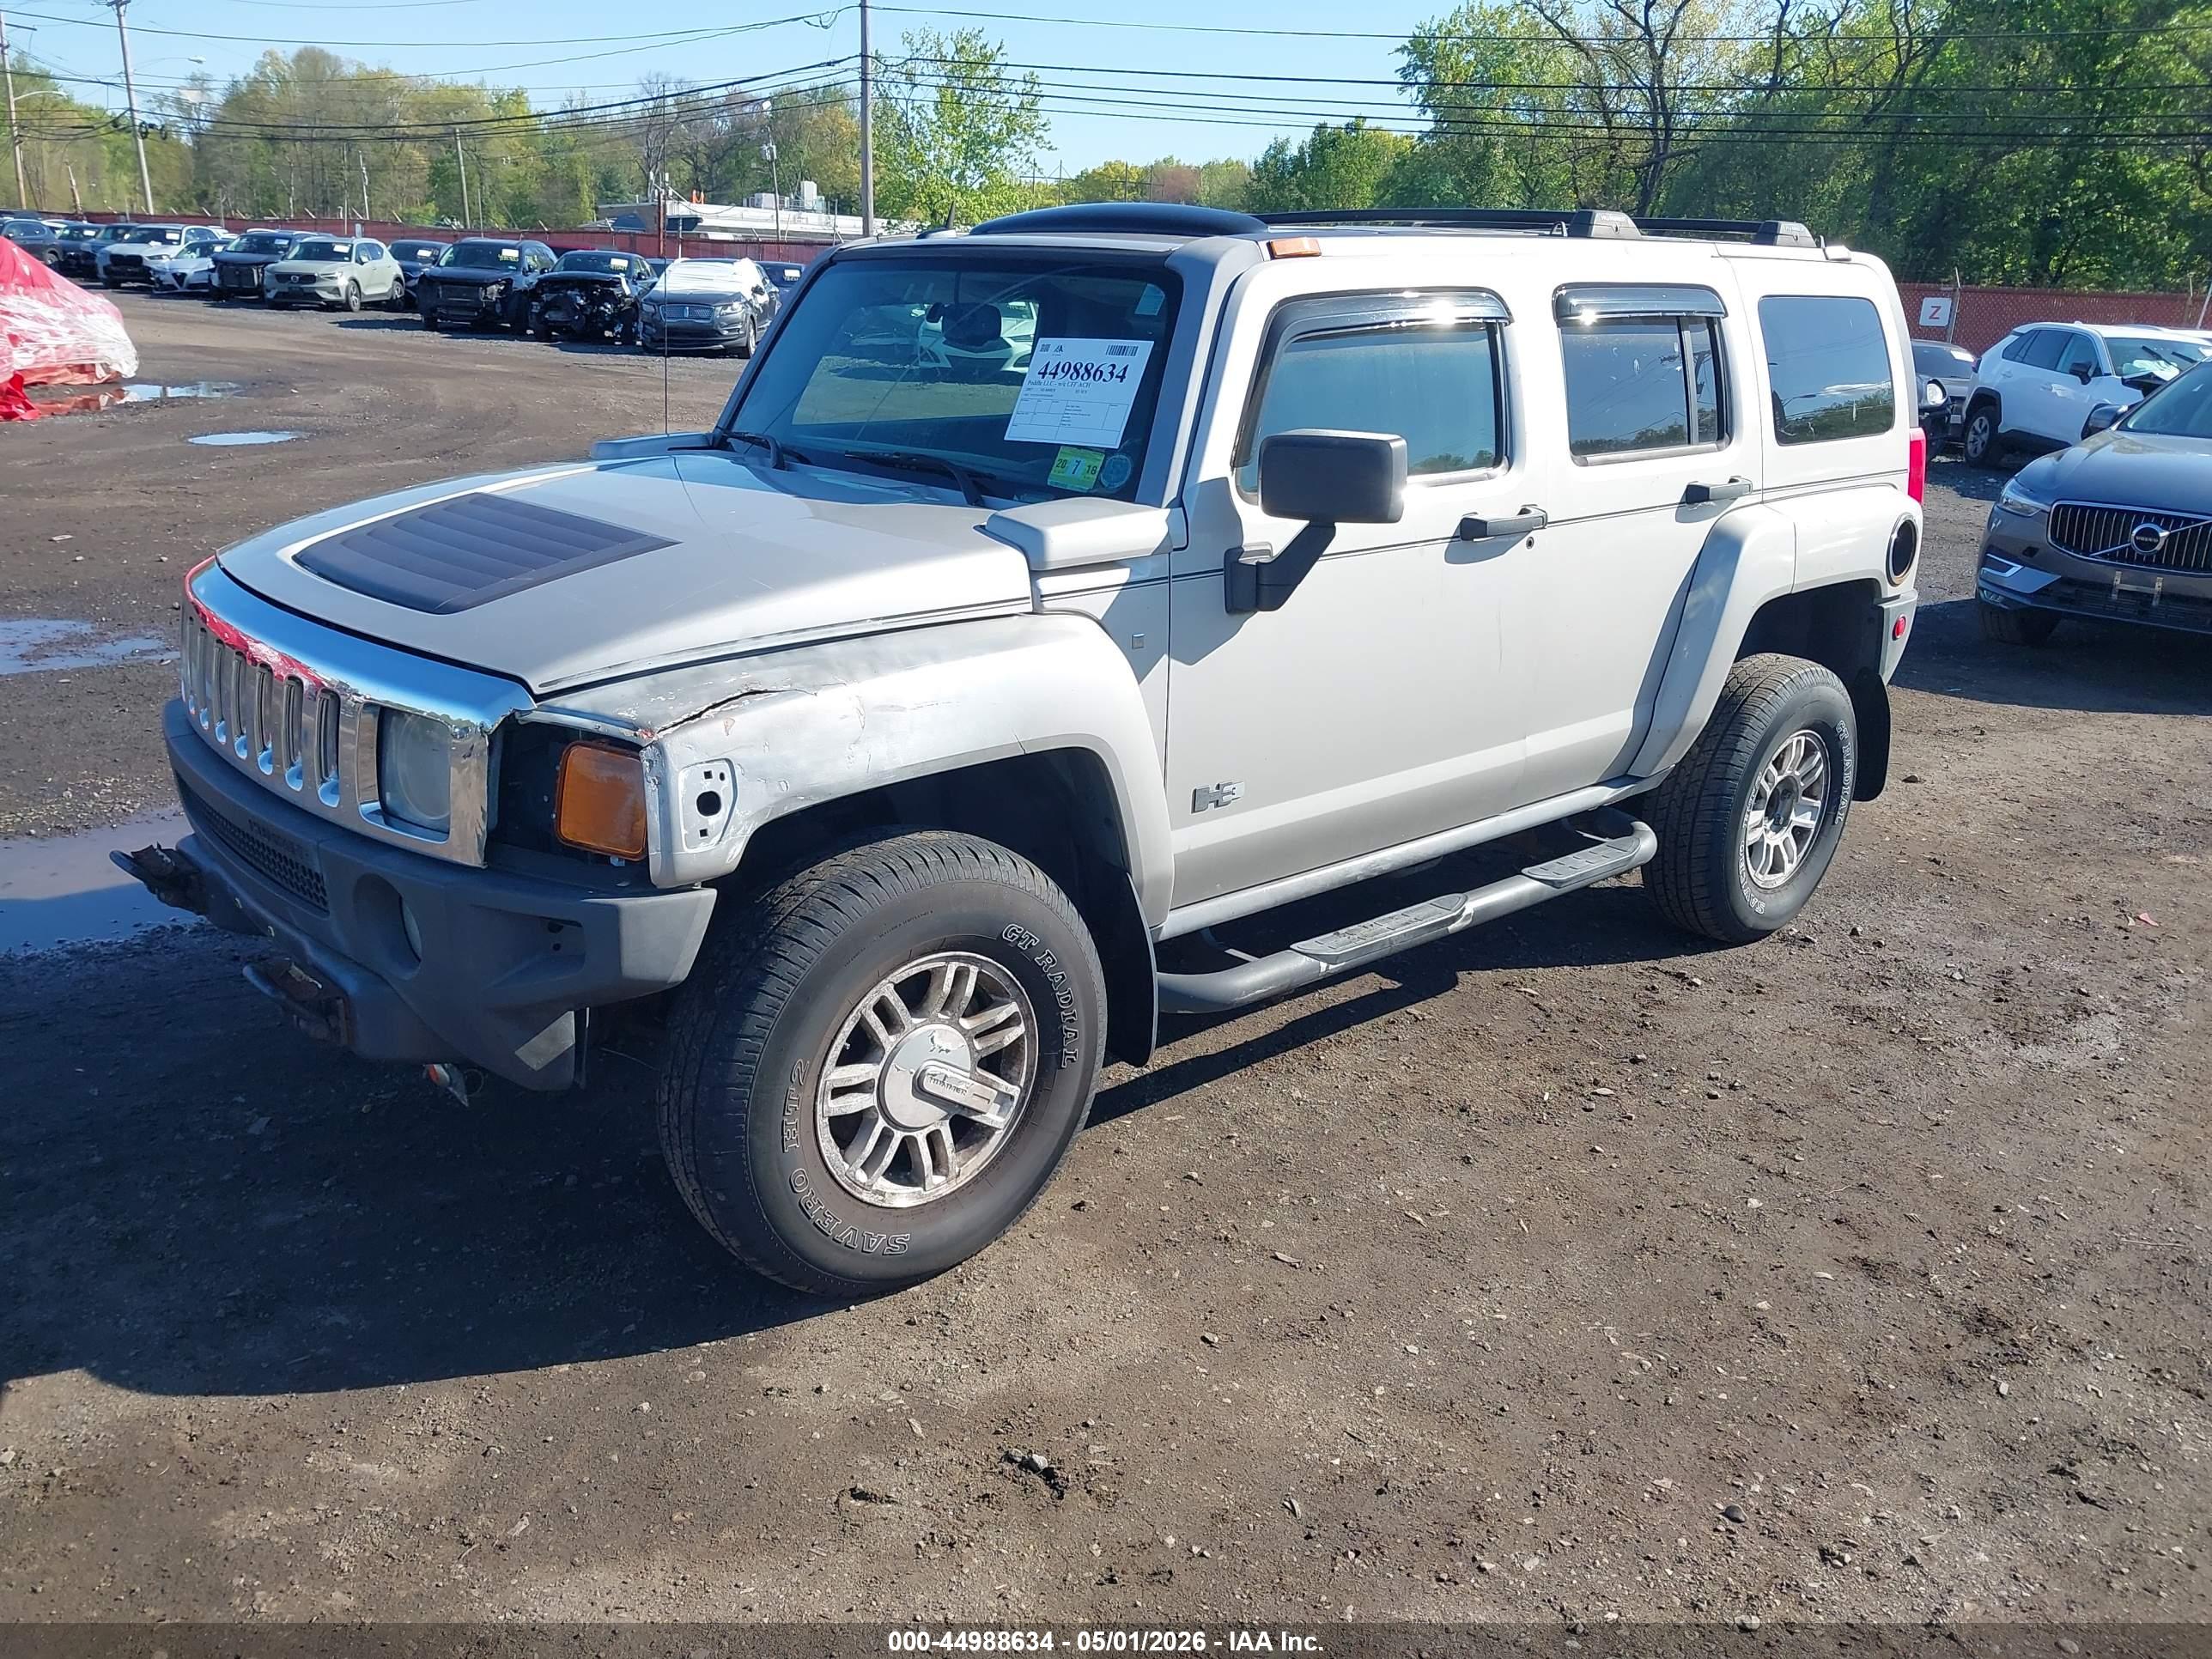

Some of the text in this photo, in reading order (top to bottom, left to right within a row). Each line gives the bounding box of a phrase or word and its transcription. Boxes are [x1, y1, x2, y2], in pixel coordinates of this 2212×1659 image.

[1928, 305, 1942, 320] Z
[1037, 361, 1129, 383] 44988634
[1056, 459, 1097, 475] 20 7 18
[1190, 781, 1244, 815] H3
[1001, 922, 1079, 1068] GT RADIAL
[789, 1168, 910, 1256] SAVERO
